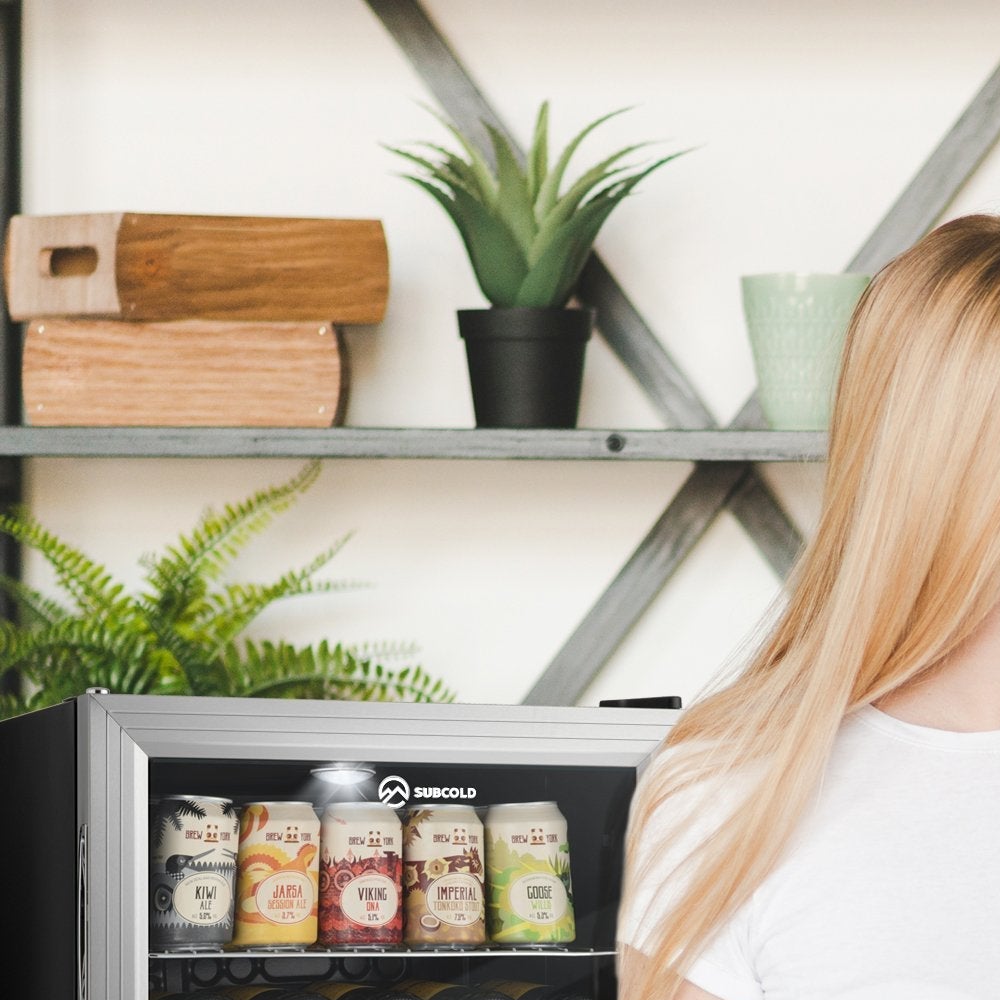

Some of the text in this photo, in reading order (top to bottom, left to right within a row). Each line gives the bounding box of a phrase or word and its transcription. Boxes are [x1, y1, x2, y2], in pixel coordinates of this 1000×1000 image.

[414, 787, 477, 798] SUBCOLD
[185, 830, 203, 840] BREW
[266, 832, 282, 841] BREW
[433, 834, 450, 843] BREW
[512, 834, 528, 844] BREW
[348, 836, 366, 845] BREW
[195, 886, 217, 900] KIWI
[273, 884, 303, 898] JARSA
[358, 887, 387, 900] VIKING
[437, 886, 477, 900] IMPERIAL
[527, 885, 552, 899] GOOSE
[200, 900, 212, 910] ALE
[268, 899, 306, 909] SESSION ALE
